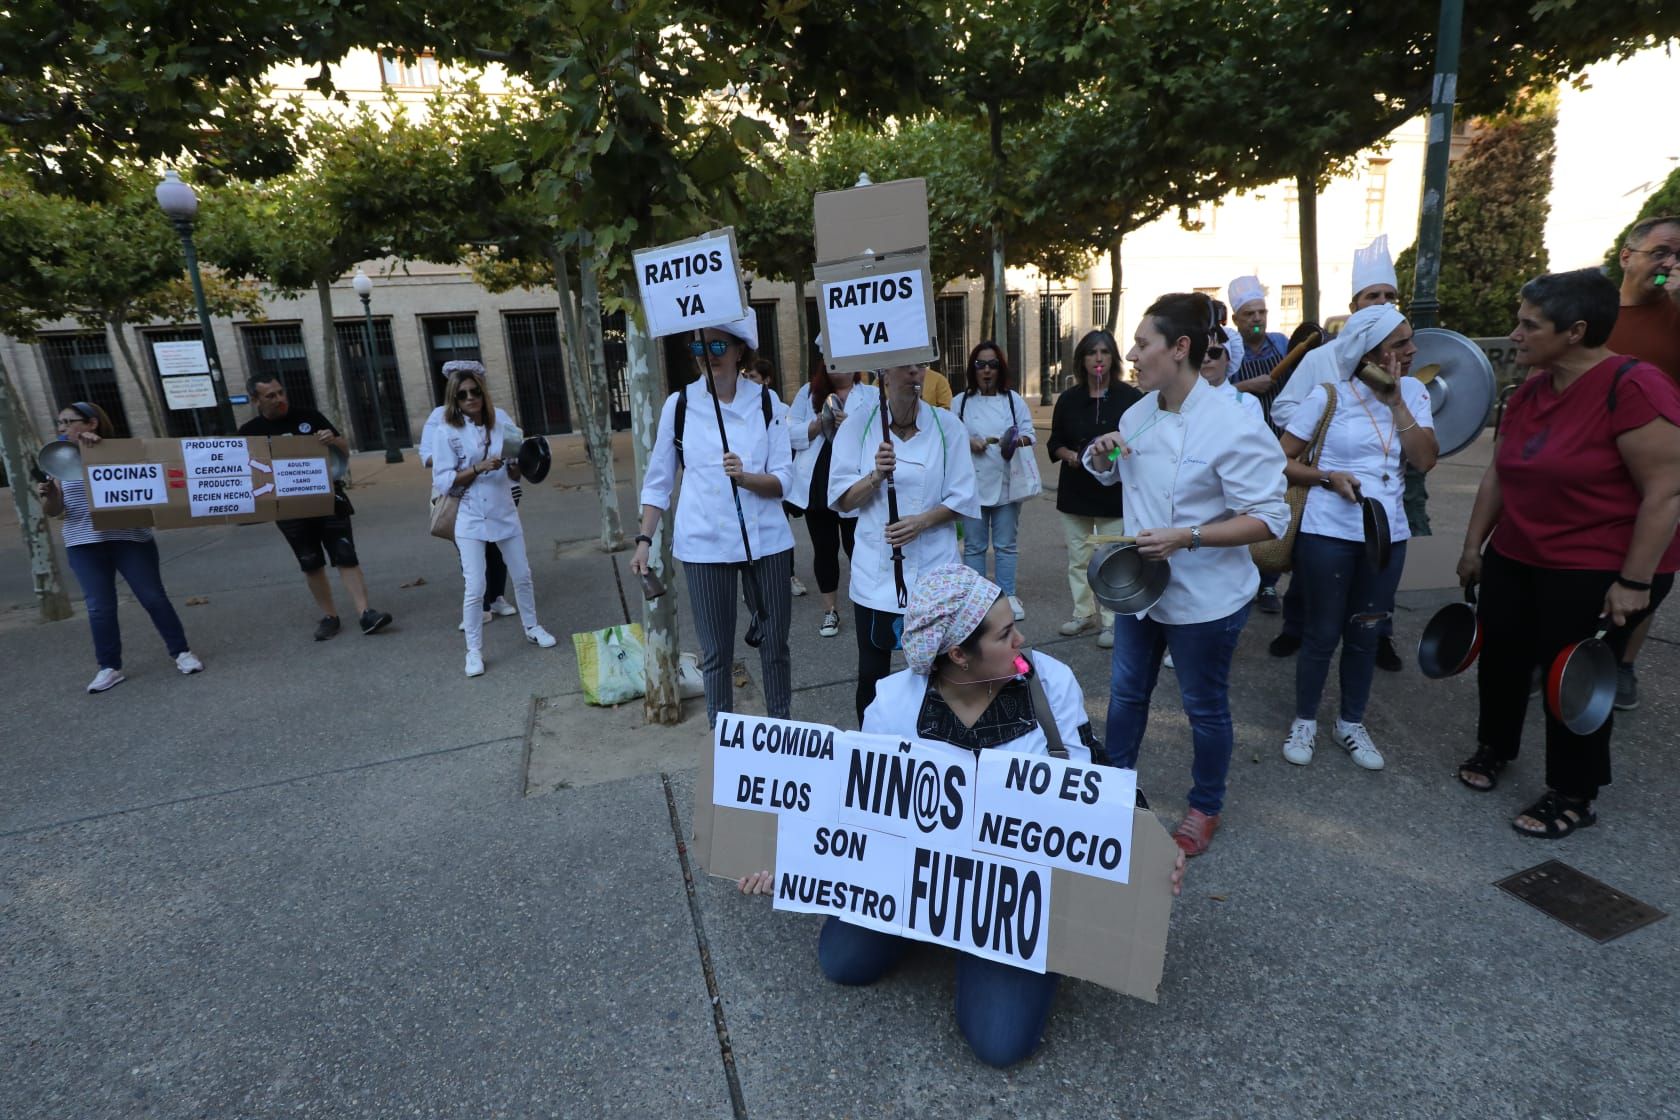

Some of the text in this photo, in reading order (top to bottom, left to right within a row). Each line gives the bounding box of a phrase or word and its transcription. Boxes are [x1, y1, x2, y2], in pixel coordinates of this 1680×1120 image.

[645, 250, 723, 286] RATIOS
[676, 294, 706, 317] YA
[829, 276, 913, 309] RATIOS
[859, 321, 889, 345] YA
[185, 440, 243, 449] PRODUCTOS
[211, 453, 224, 461] DE
[92, 466, 157, 481] COCINAS
[195, 465, 243, 475] CERCANIA
[198, 479, 243, 488] PRODUCTO:
[104, 488, 153, 503] INSITU
[192, 491, 252, 502] RECIEN HECHO,
[208, 505, 239, 514] FRESCO
[719, 718, 835, 760] LA COMIDA
[736, 774, 812, 812] DE LOS
[845, 741, 967, 833] NIÑ@S
[1005, 757, 1103, 805] NO ES
[813, 826, 867, 861] SON
[978, 812, 1122, 871] NEGOCIO
[779, 872, 896, 922] NUESTRO
[908, 847, 1042, 960] FUTURO
